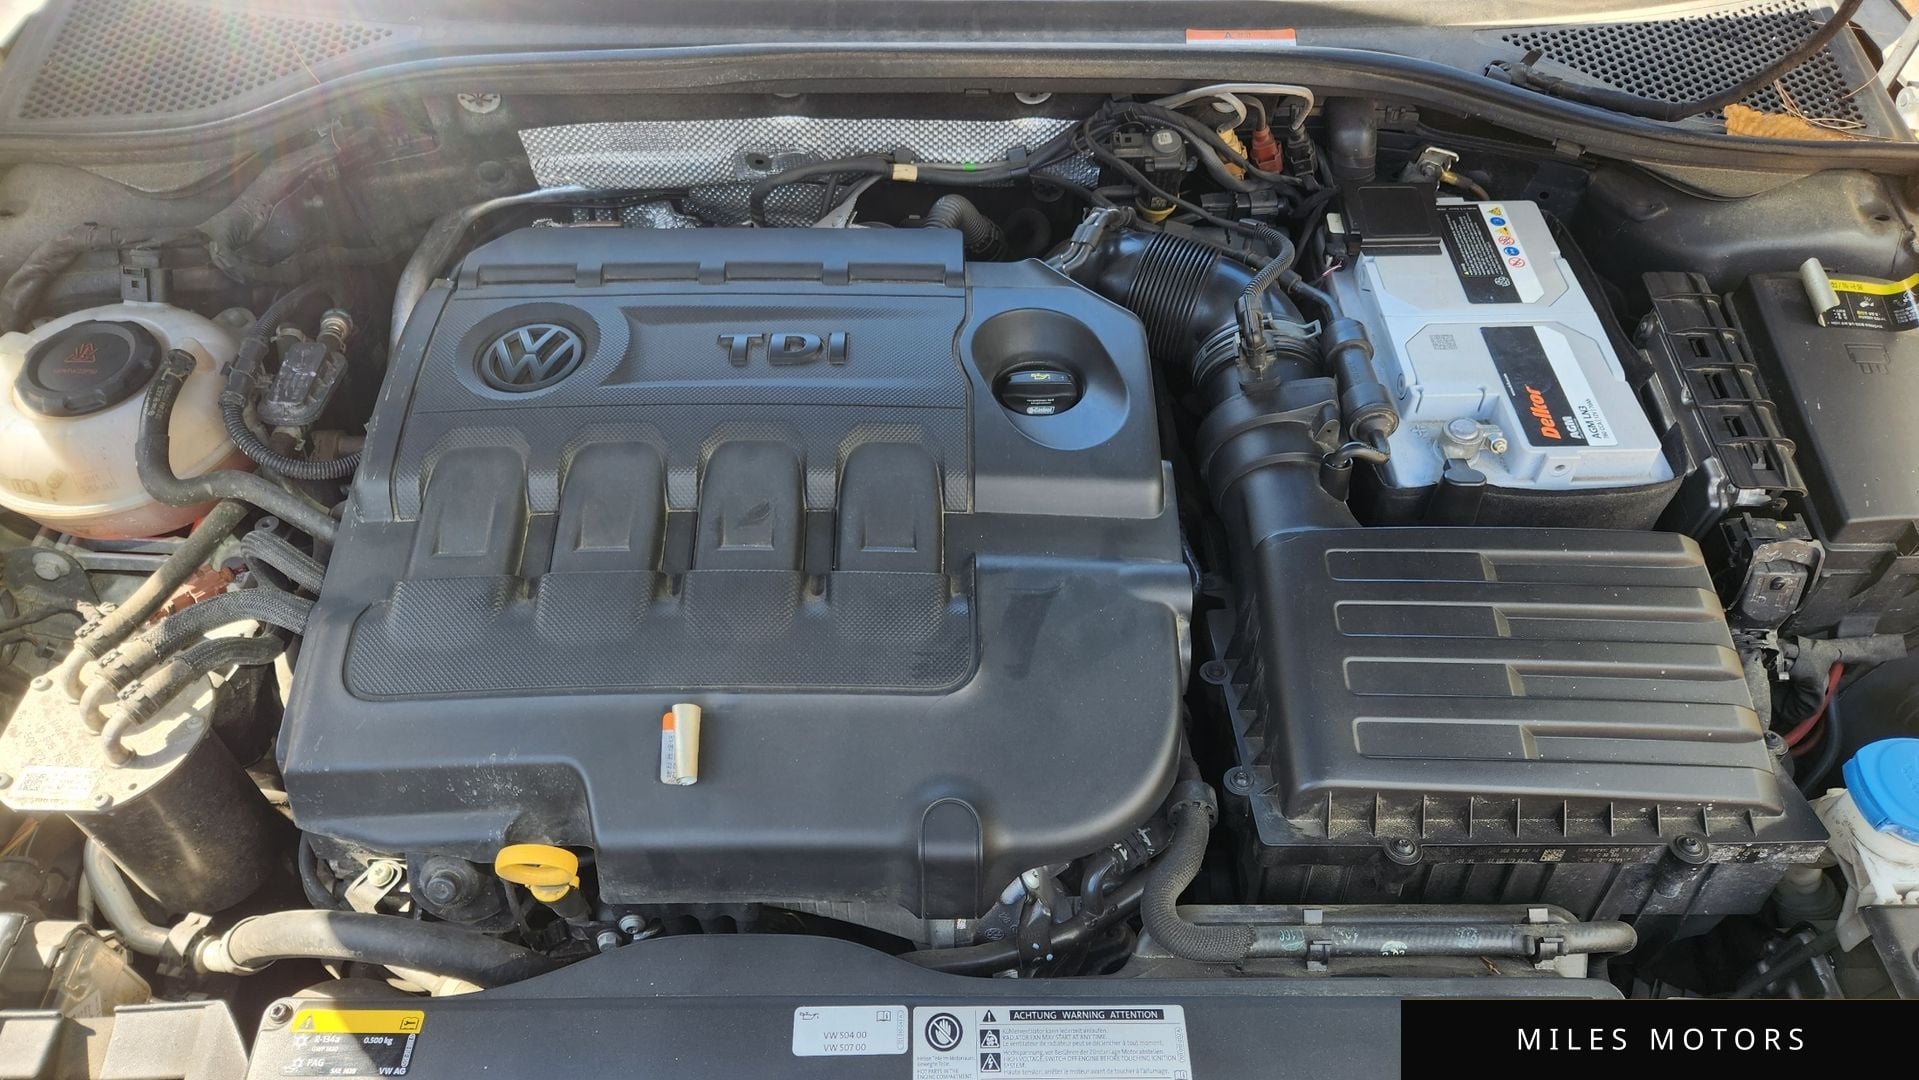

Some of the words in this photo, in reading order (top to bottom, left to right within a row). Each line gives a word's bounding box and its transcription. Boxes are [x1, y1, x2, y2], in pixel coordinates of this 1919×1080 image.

[717, 331, 850, 366] TDI
[1525, 384, 1562, 440] Delkor
[1562, 416, 1582, 439] AGM
[1585, 418, 1602, 439] AGM
[1013, 1011, 1057, 1020] ACHTUNG
[1062, 1010, 1105, 1019] WARNING
[1110, 1010, 1158, 1019] ATTENTION
[363, 1036, 383, 1044] 0.500
[384, 1037, 394, 1046] kg
[823, 1031, 838, 1039] VW
[840, 1031, 854, 1039] 504
[856, 1031, 867, 1039] 00
[307, 1059, 325, 1067] PAG
